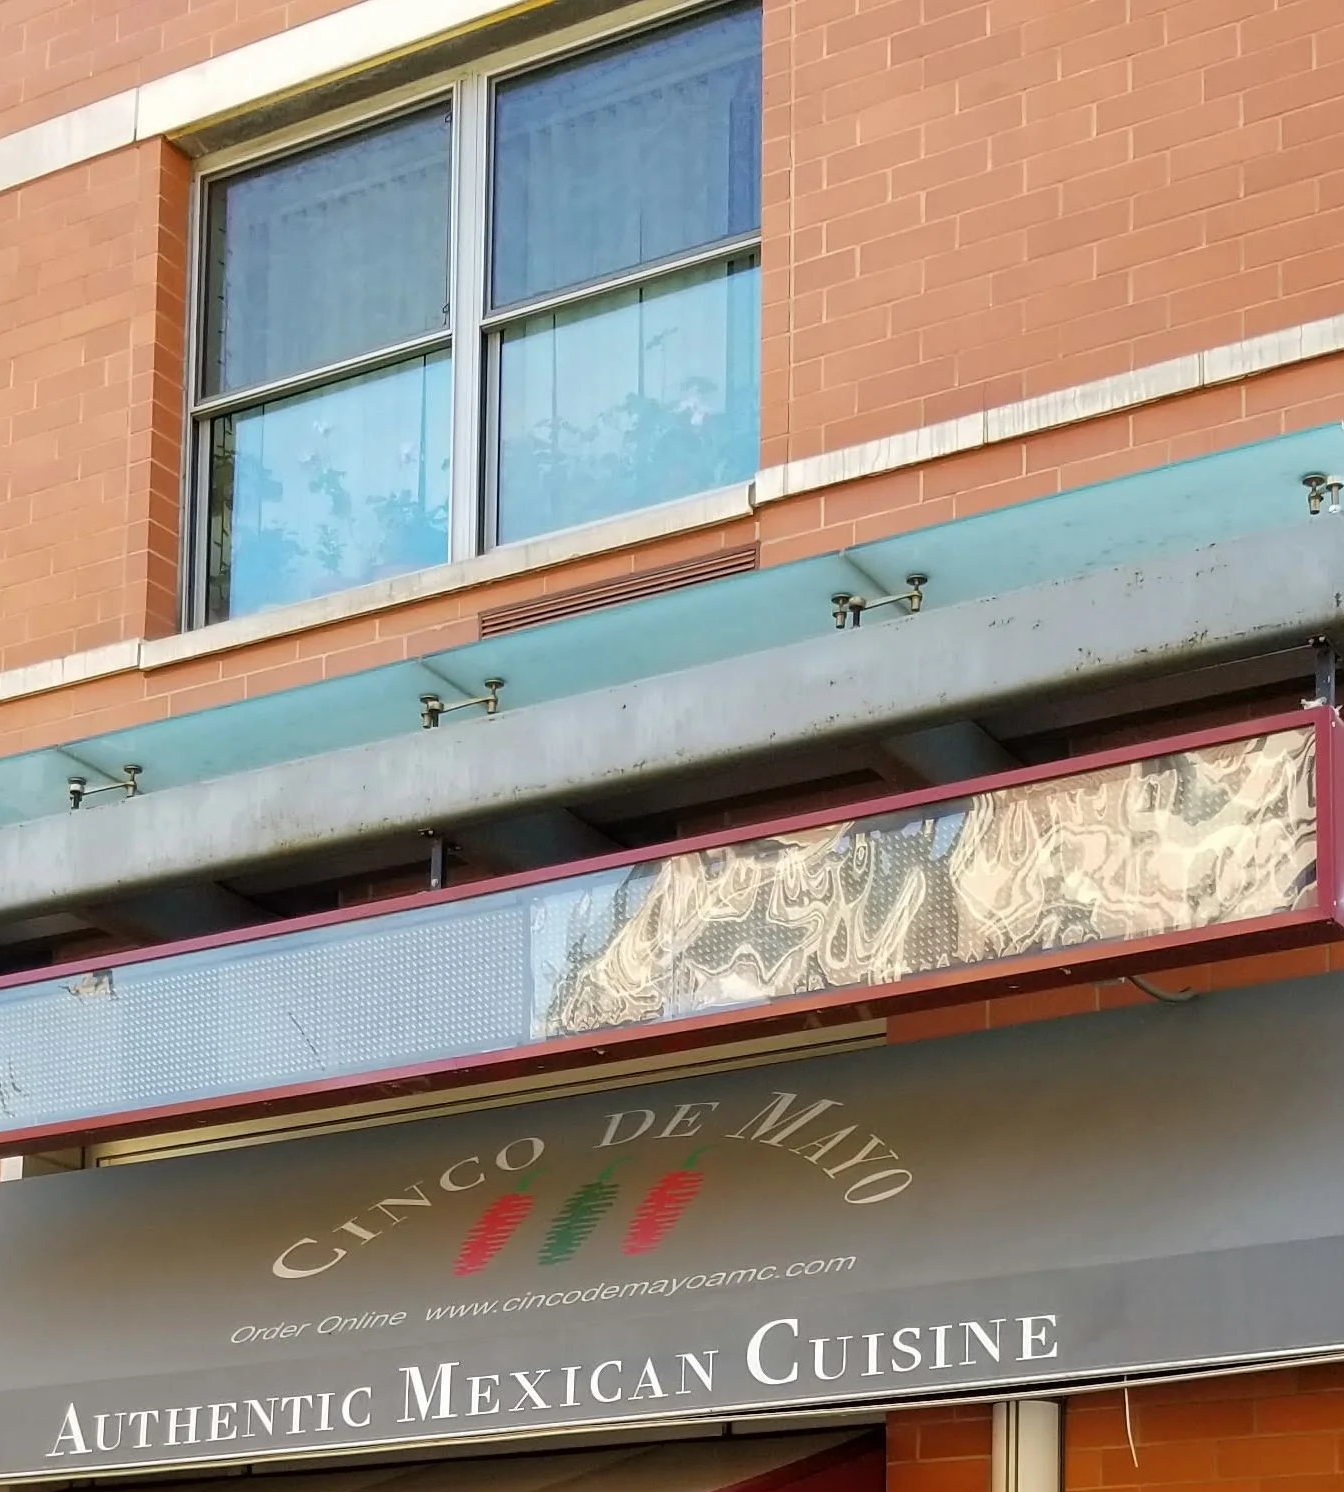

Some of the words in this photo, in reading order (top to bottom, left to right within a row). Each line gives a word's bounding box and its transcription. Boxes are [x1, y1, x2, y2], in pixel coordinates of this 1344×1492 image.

[272, 1137, 545, 1279] CINCO
[593, 1101, 719, 1148] DE
[726, 1091, 913, 1204] MAYO
[230, 1316, 309, 1344] Order
[318, 1308, 407, 1334] Online
[425, 1256, 857, 1321] www.cincodemayoamc.com
[46, 1383, 373, 1457] AUTHENTIC
[398, 1350, 719, 1422] MEXICAN
[745, 1313, 1058, 1388] CUISINE
